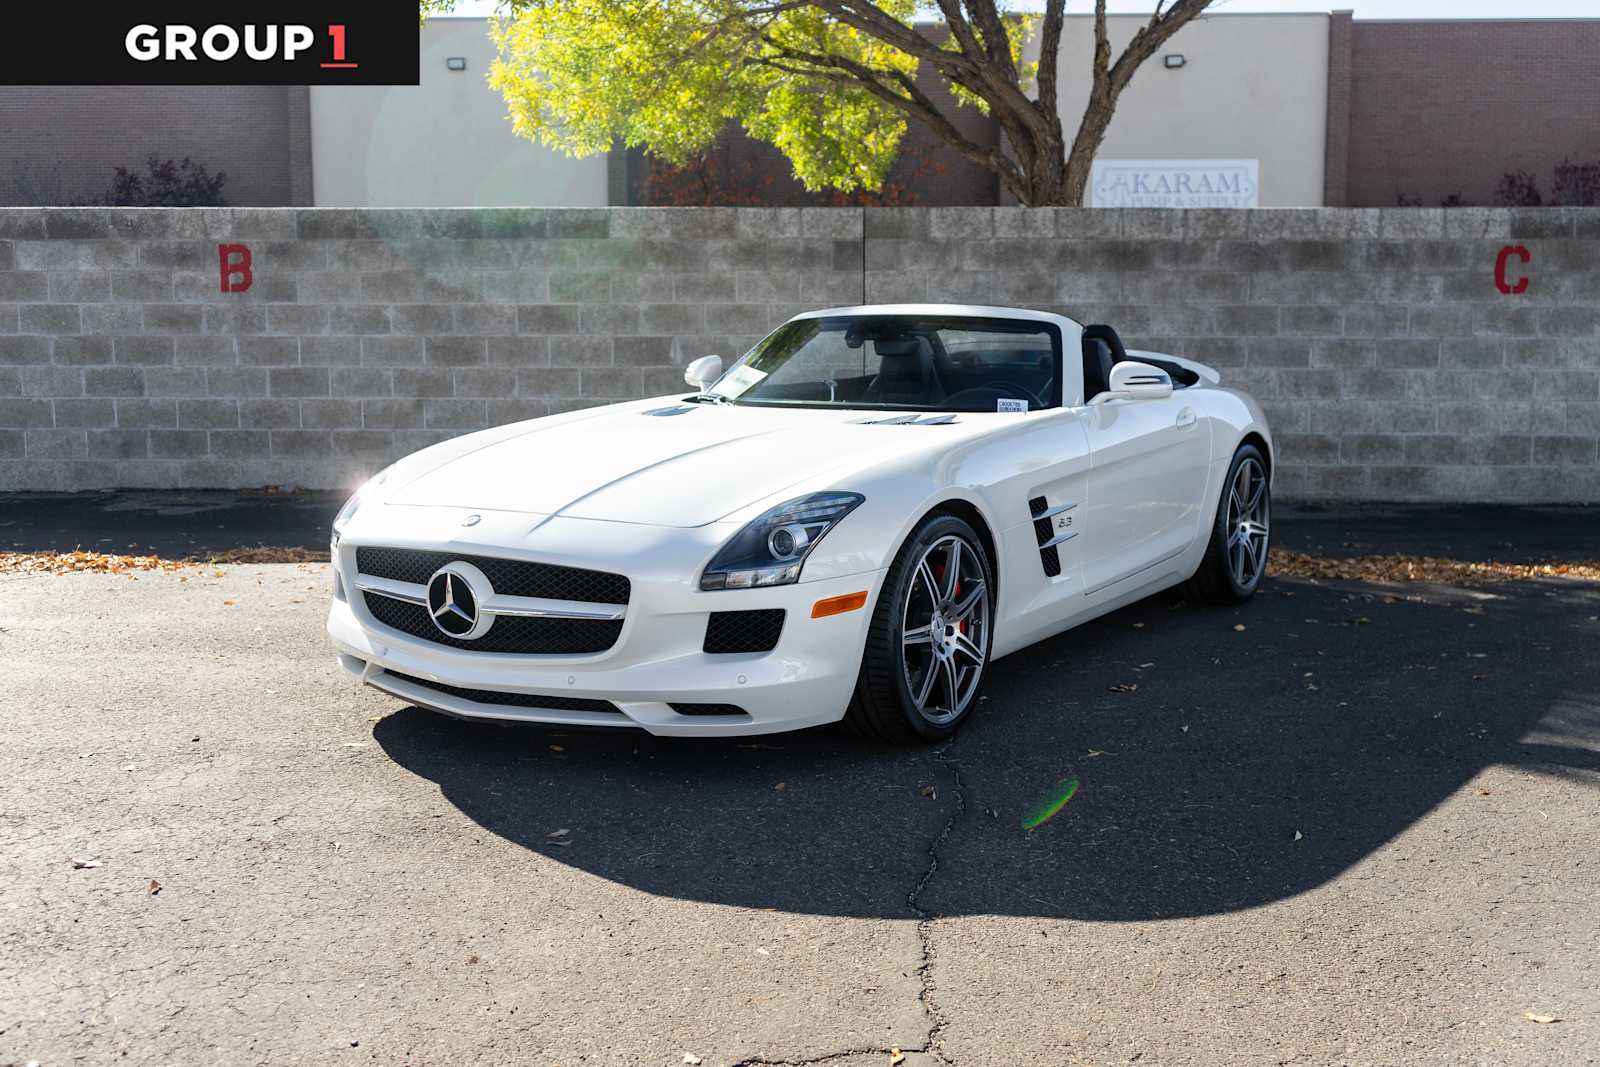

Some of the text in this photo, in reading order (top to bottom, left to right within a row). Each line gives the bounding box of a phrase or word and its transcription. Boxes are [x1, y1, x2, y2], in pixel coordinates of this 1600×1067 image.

[1132, 173, 1241, 194] KARAM
[219, 244, 252, 292] B
[1495, 246, 1530, 294] C
